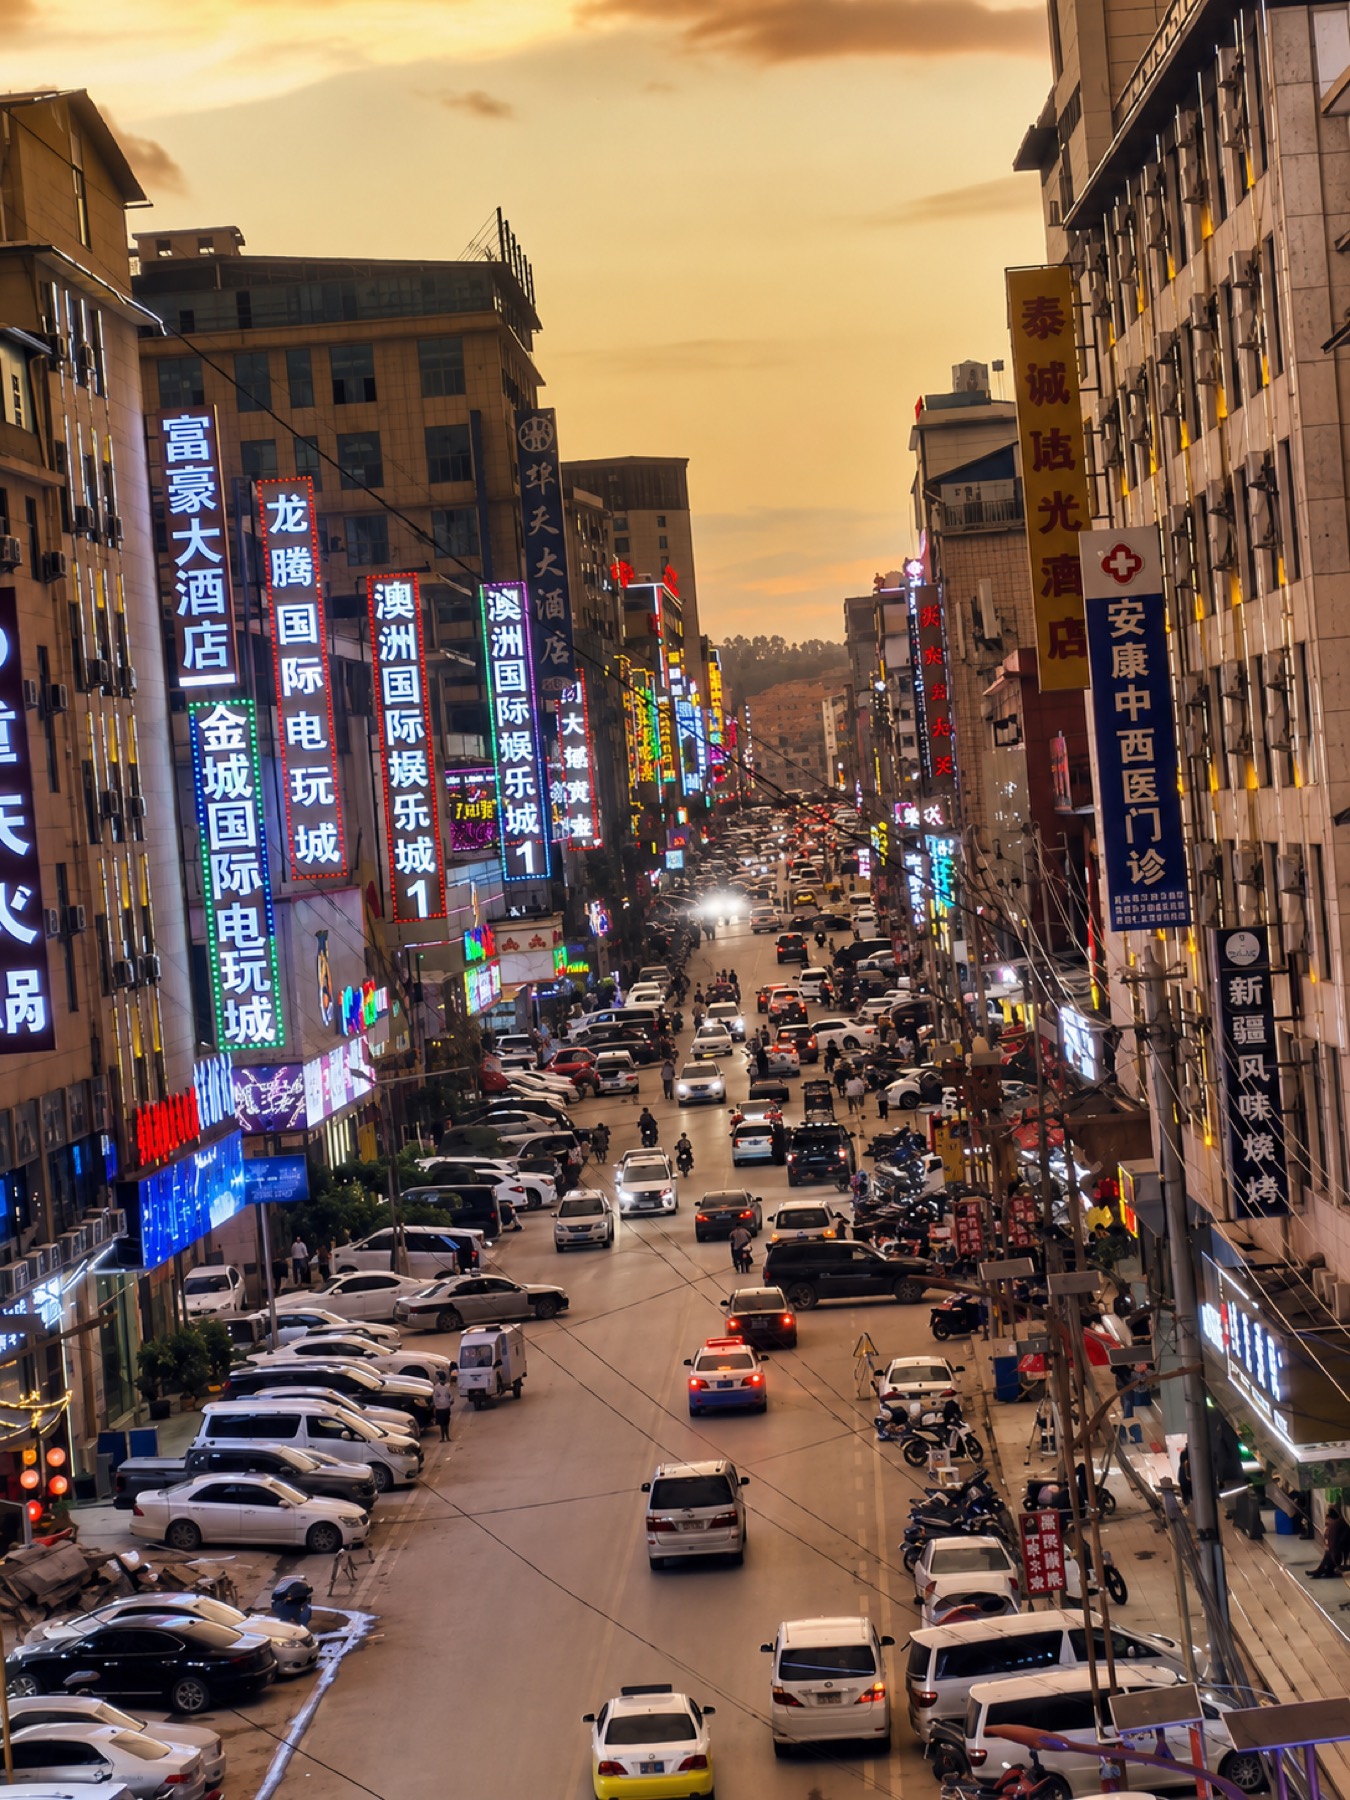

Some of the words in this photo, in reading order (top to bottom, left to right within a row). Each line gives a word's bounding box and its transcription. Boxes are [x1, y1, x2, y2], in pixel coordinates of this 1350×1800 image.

[162, 414, 229, 669] 富豪大酒店
[266, 493, 342, 866] 龙腾国际电玩城
[197, 704, 278, 1046] 金城国际电玩城
[1106, 600, 1168, 888] 安康中西医门诊
